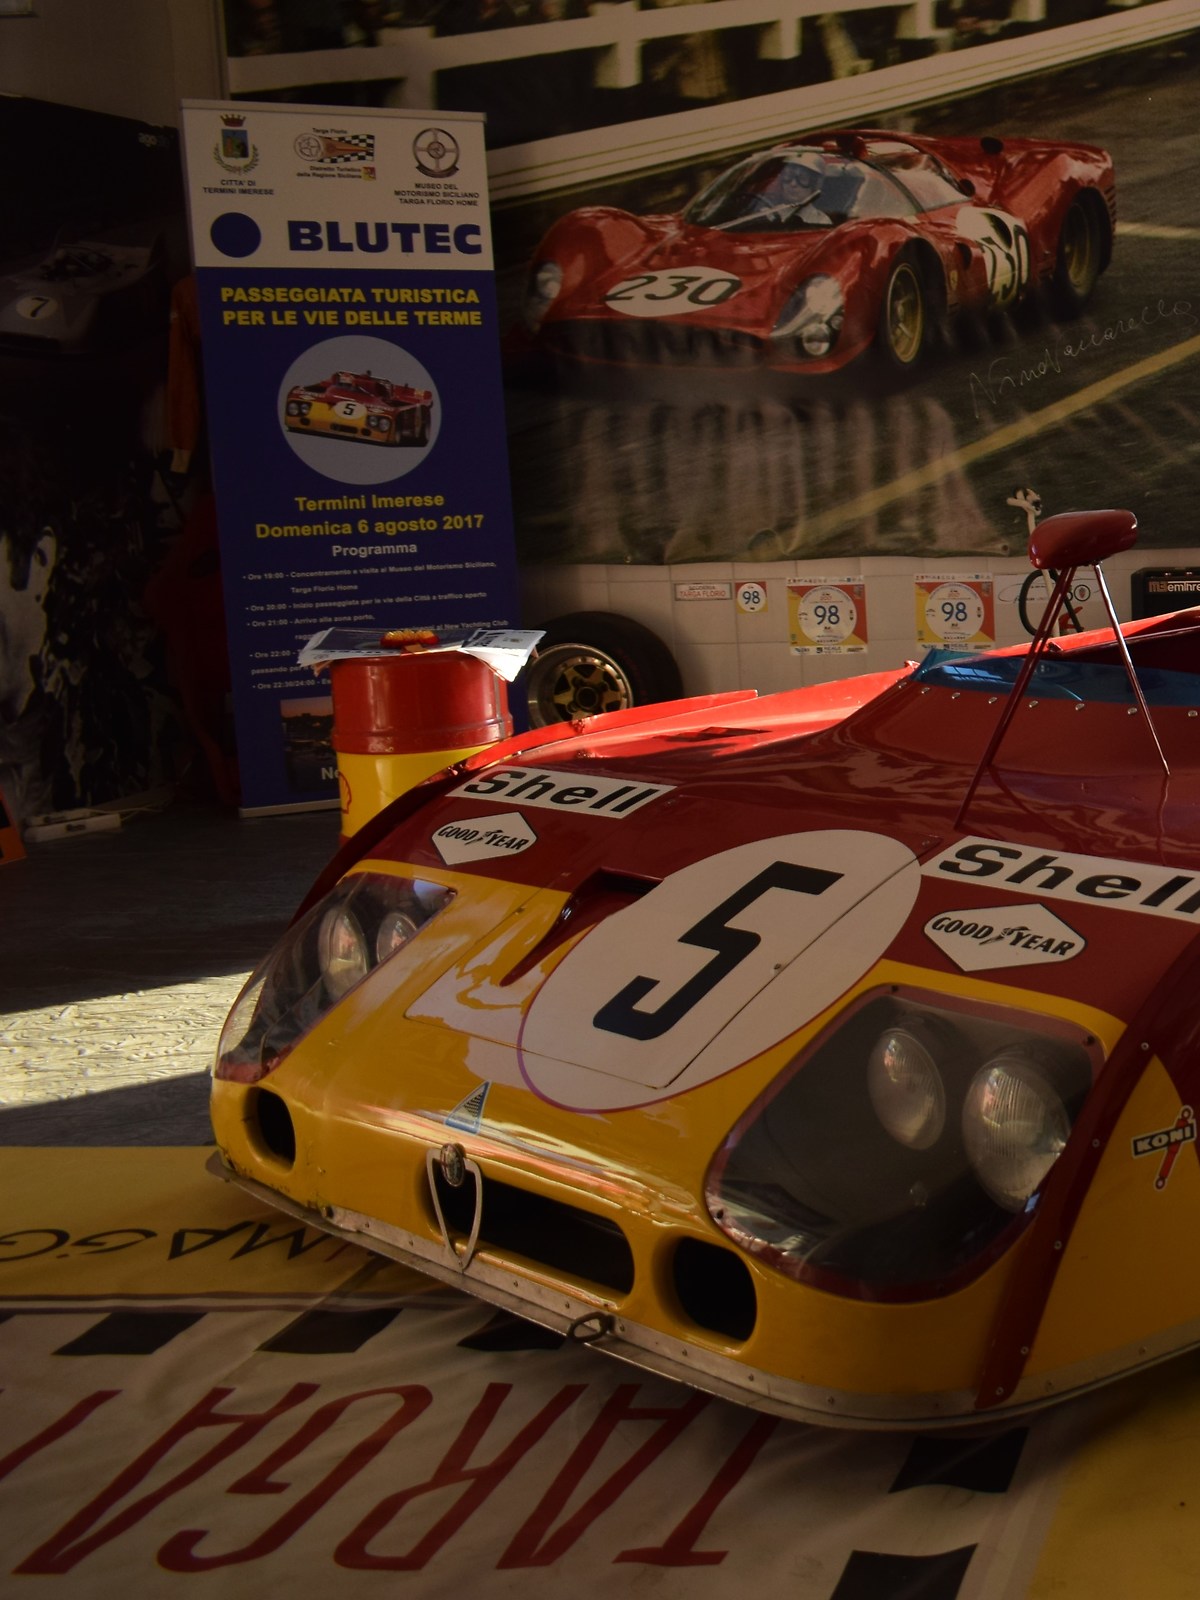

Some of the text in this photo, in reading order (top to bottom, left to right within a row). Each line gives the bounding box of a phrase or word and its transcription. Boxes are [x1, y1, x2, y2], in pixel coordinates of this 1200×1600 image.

[426, 198, 454, 206] FLORIO
[442, 191, 480, 199] SICILIANO
[287, 220, 482, 255] BLUTEC
[220, 287, 480, 304] PASSEGGIATA TURISTICA
[606, 274, 741, 306] 230
[29, 297, 49, 318] 7
[223, 310, 482, 326] PER LE VIE DELLE TERME
[343, 403, 355, 416] 5
[294, 493, 445, 512] Termini Imerese
[255, 514, 485, 539] Domenica 6 agosto 2017
[331, 543, 418, 559] Programma
[290, 586, 312, 594] Targa
[742, 590, 761, 605] 98
[814, 604, 841, 626] 98
[941, 601, 968, 623] 98
[463, 770, 660, 813] Shell
[592, 860, 845, 1041] 5
[1135, 1125, 1193, 1153] KONI
[12, 1383, 781, 1574] TARGA
